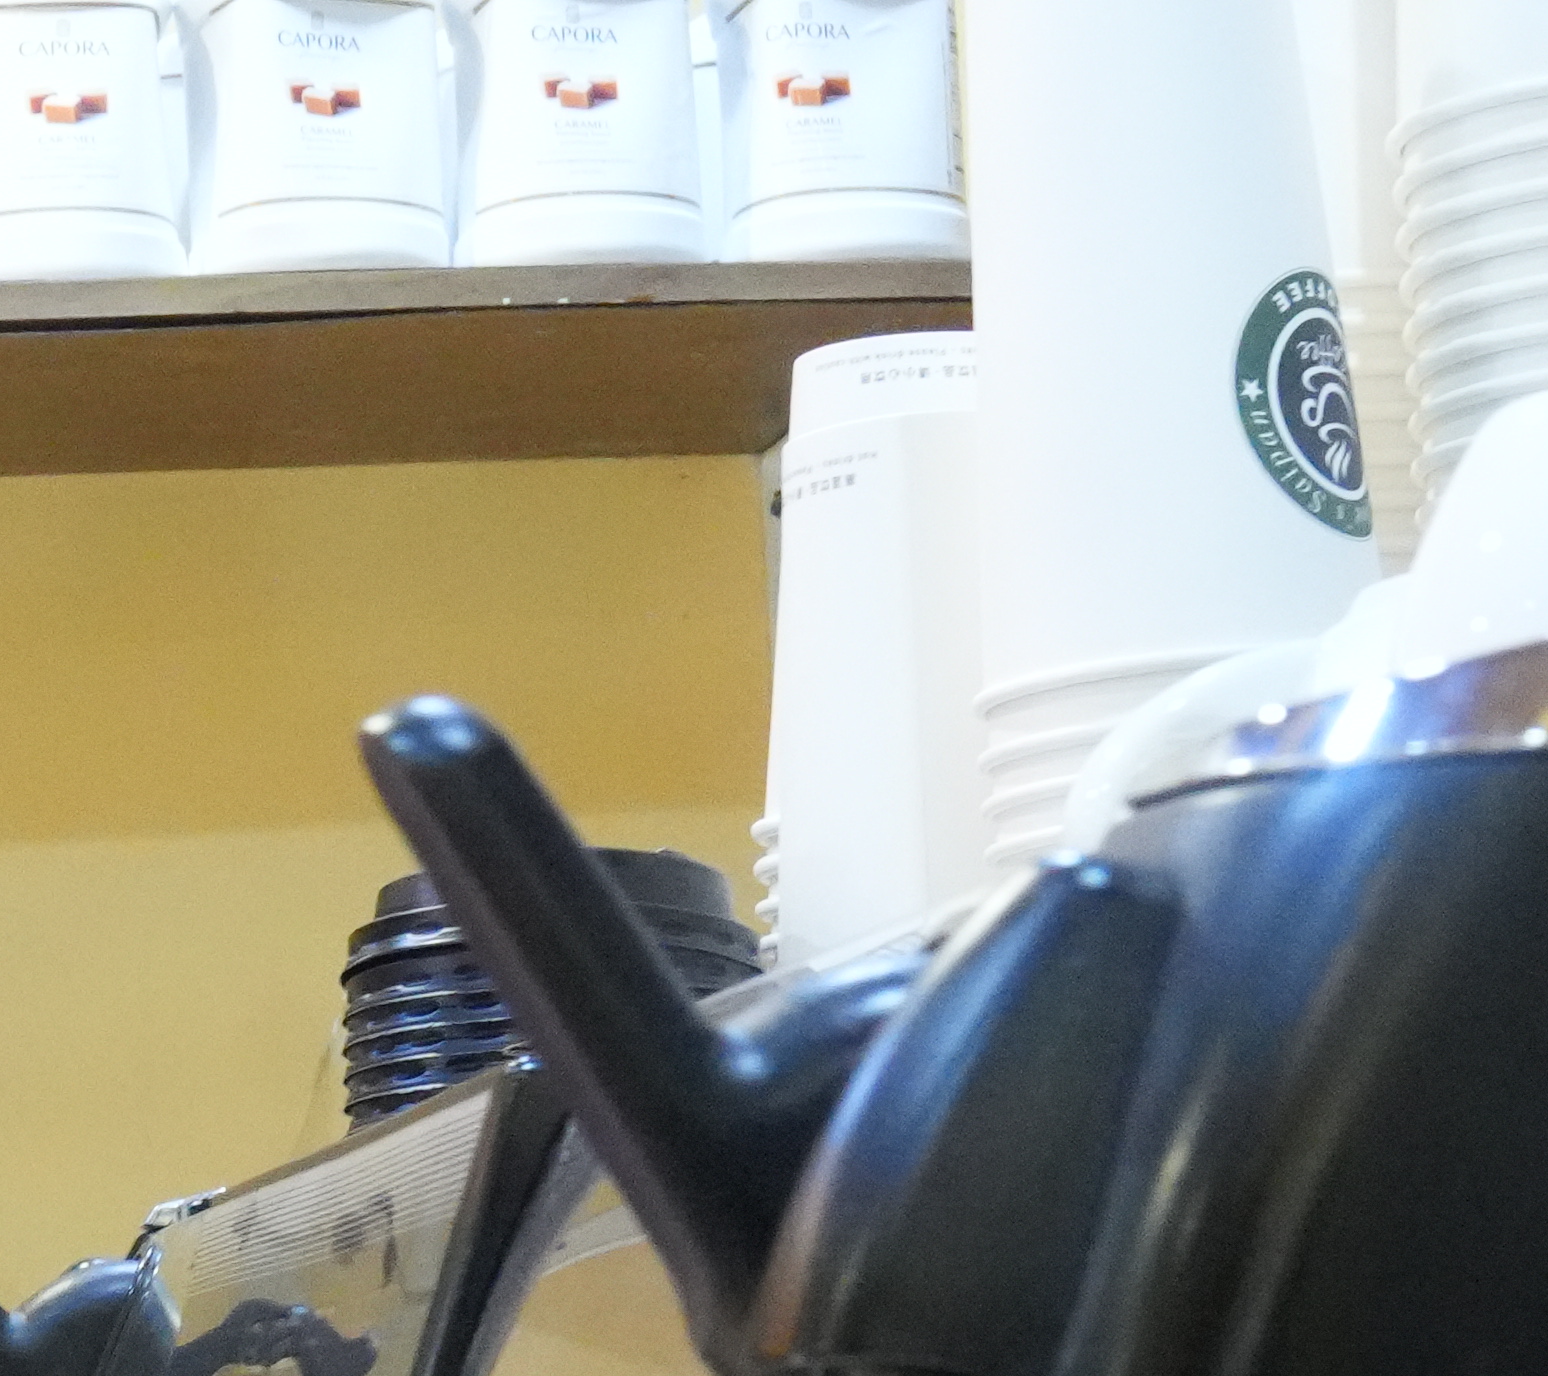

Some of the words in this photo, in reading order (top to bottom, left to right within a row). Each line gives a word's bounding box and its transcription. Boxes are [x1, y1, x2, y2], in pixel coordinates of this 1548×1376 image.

[277, 28, 362, 53] CAPORA
[530, 23, 618, 45] CAPORA
[765, 21, 851, 42] CAPORA
[18, 38, 111, 58] CAPORA
